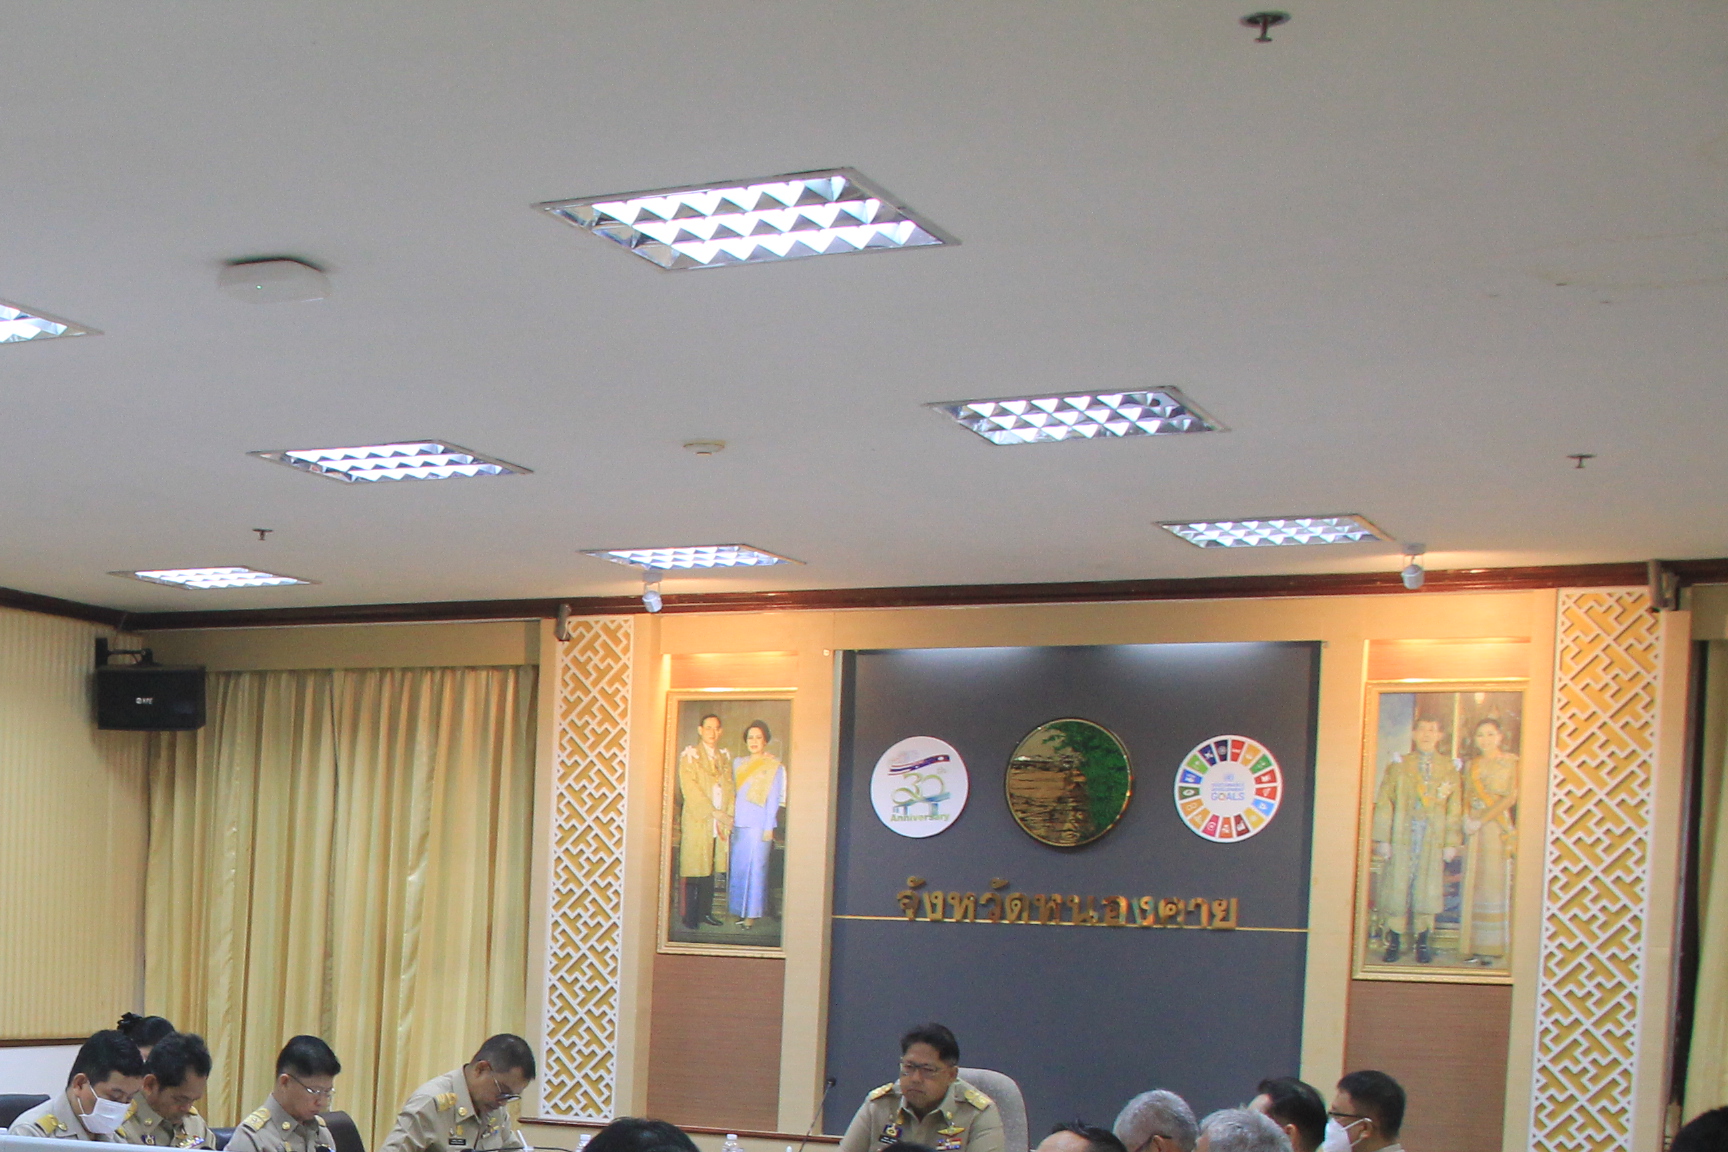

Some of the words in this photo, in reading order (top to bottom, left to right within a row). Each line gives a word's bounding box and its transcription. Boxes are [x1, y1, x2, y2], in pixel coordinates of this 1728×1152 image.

[1211, 792, 1245, 801] GOALS
[890, 813, 950, 823] Anniversary
[895, 875, 1240, 931] จังหวัดหนองคาย
